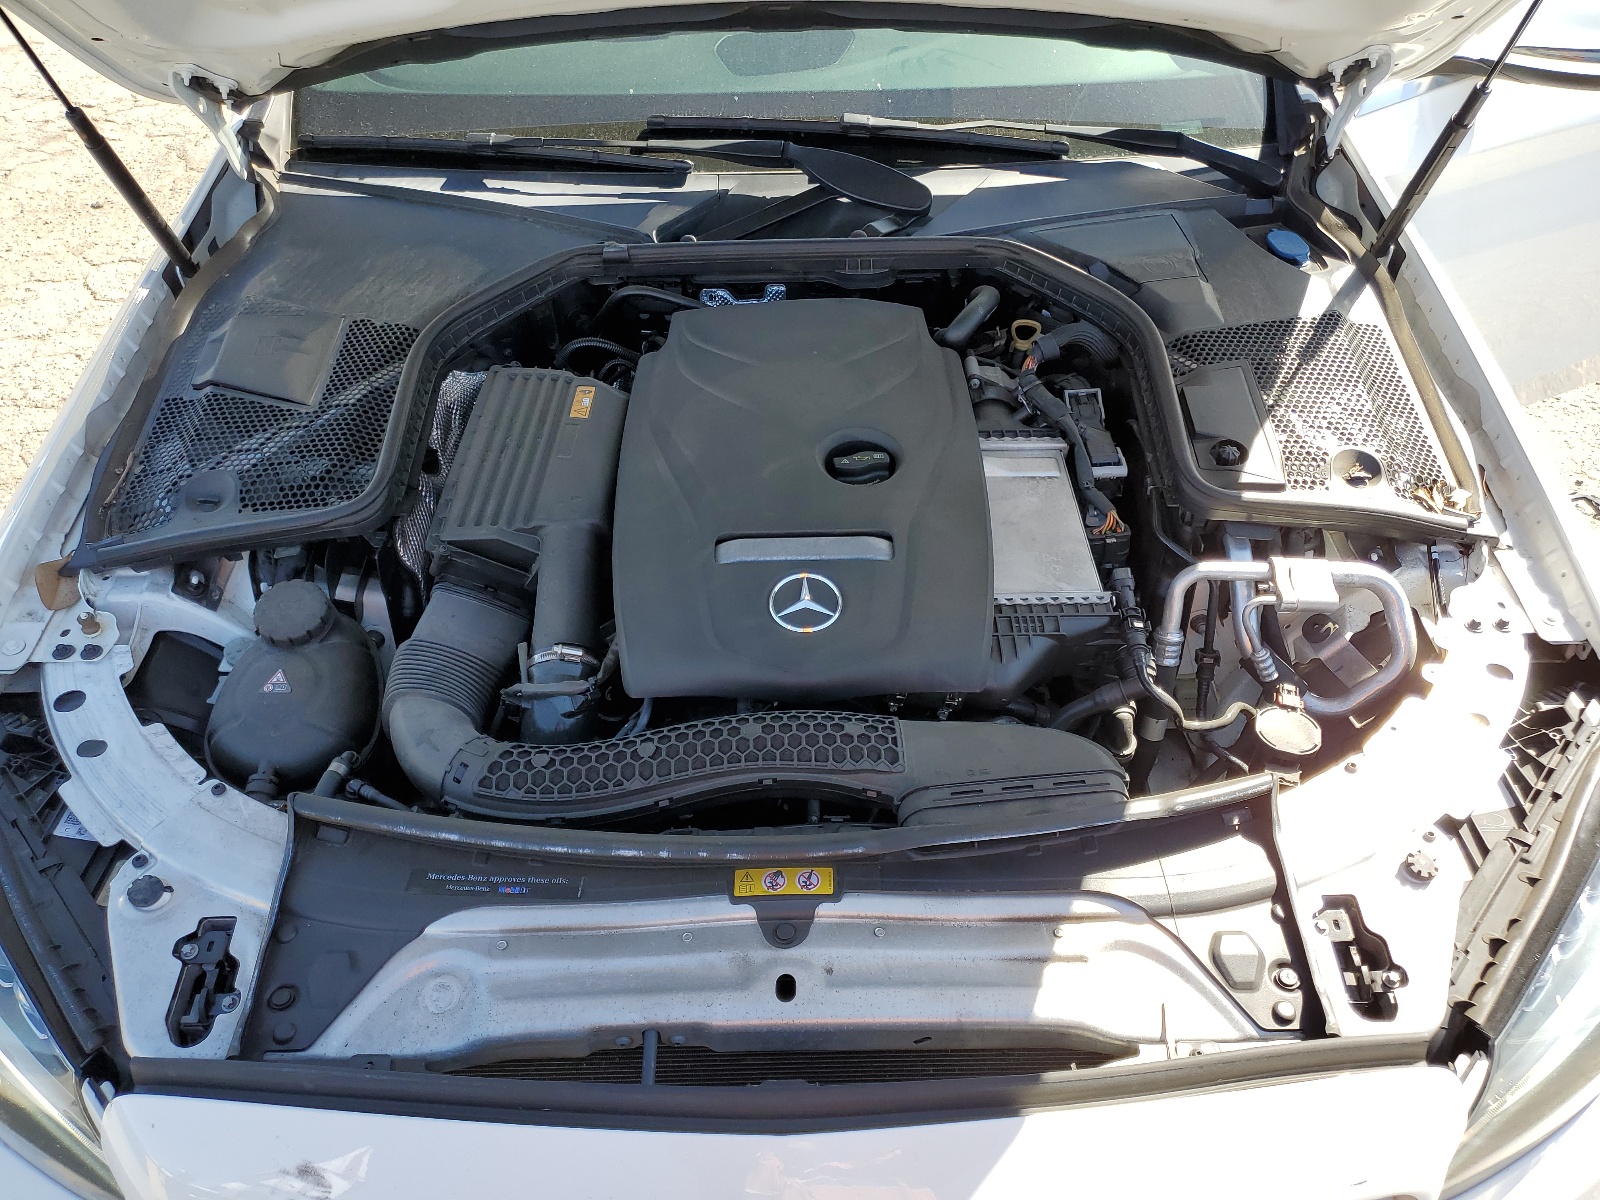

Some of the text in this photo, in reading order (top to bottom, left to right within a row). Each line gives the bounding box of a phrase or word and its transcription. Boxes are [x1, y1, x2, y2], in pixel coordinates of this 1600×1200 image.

[426, 872, 488, 882] Mercedes-Benz
[489, 875, 527, 884] approves
[528, 876, 550, 884] these
